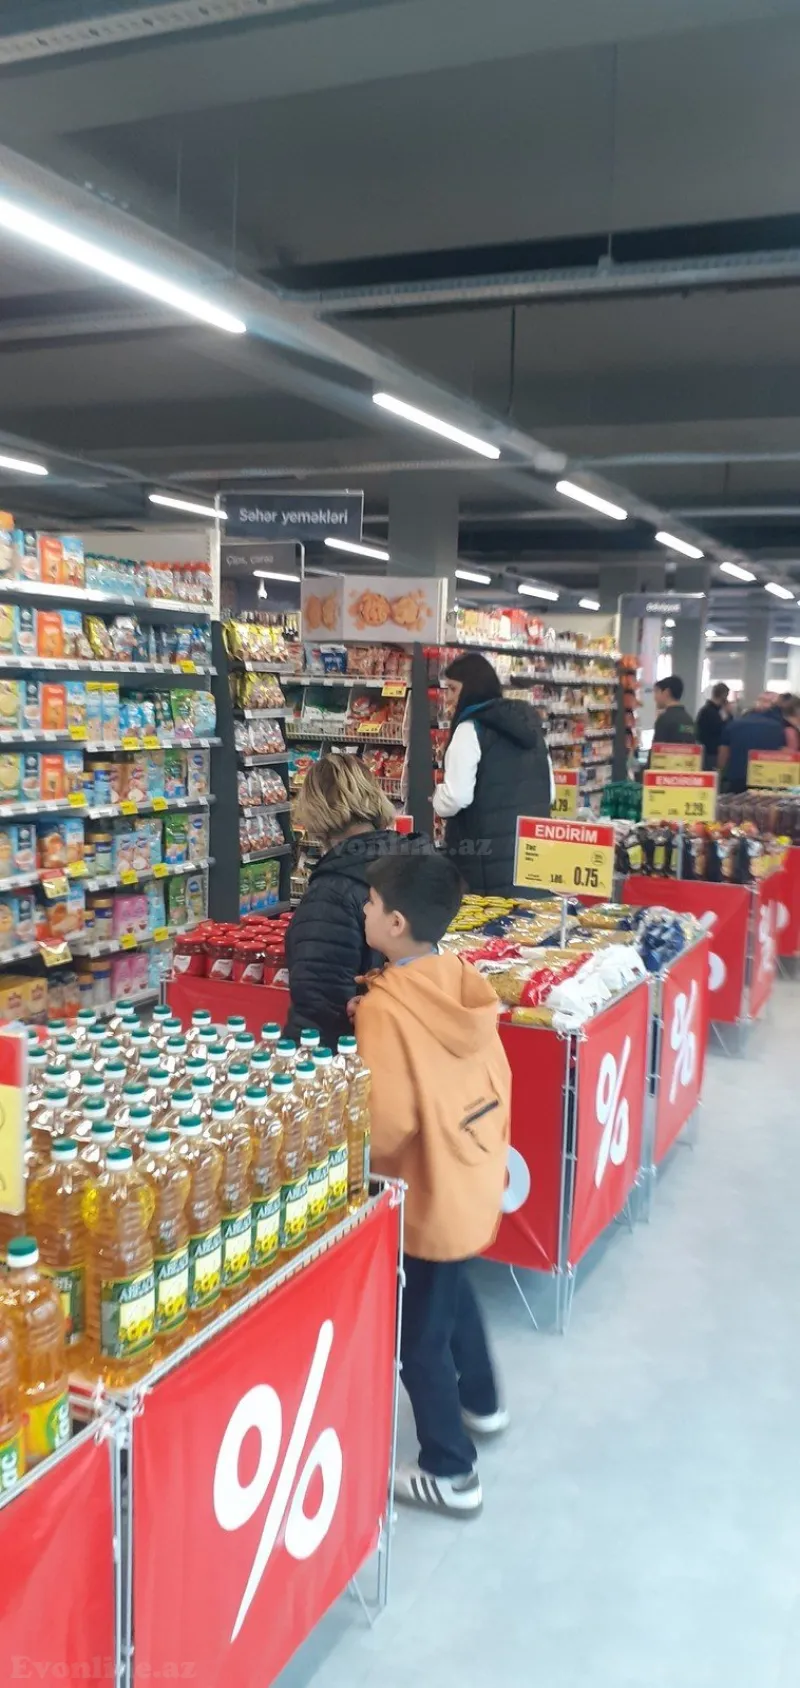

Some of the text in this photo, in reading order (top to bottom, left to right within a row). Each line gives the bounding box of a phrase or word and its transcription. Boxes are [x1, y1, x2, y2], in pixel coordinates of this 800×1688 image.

[240, 508, 348, 525] Səhər yeməkləri
[535, 824, 598, 843] ENDİRİM
[574, 866, 598, 888] 0.75
